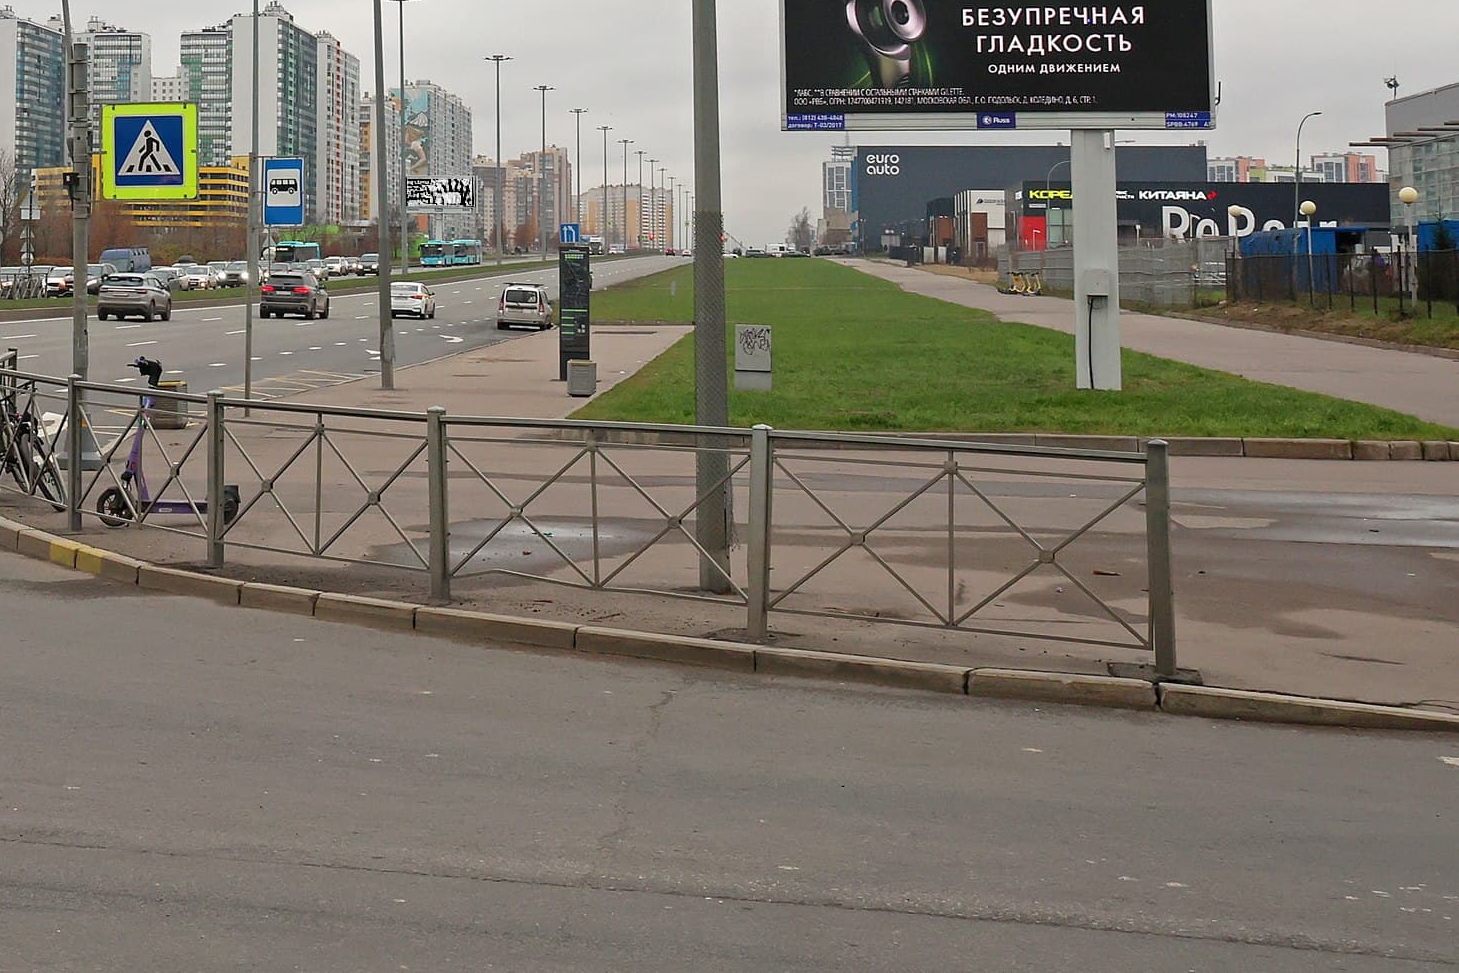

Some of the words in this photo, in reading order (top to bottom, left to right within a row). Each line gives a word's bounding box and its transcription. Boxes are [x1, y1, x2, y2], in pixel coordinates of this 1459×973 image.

[962, 6, 1145, 26] БЕЗУПРЕЧНАЯ
[976, 34, 1132, 56] ГЛАДКОСТЬ
[988, 64, 1036, 75] ОДНИМ
[1039, 63, 1121, 75] ДВИЖЕНИЕМ
[866, 154, 900, 164] euro
[866, 163, 900, 175] auto
[1139, 190, 1207, 200] КИТАЯНА
